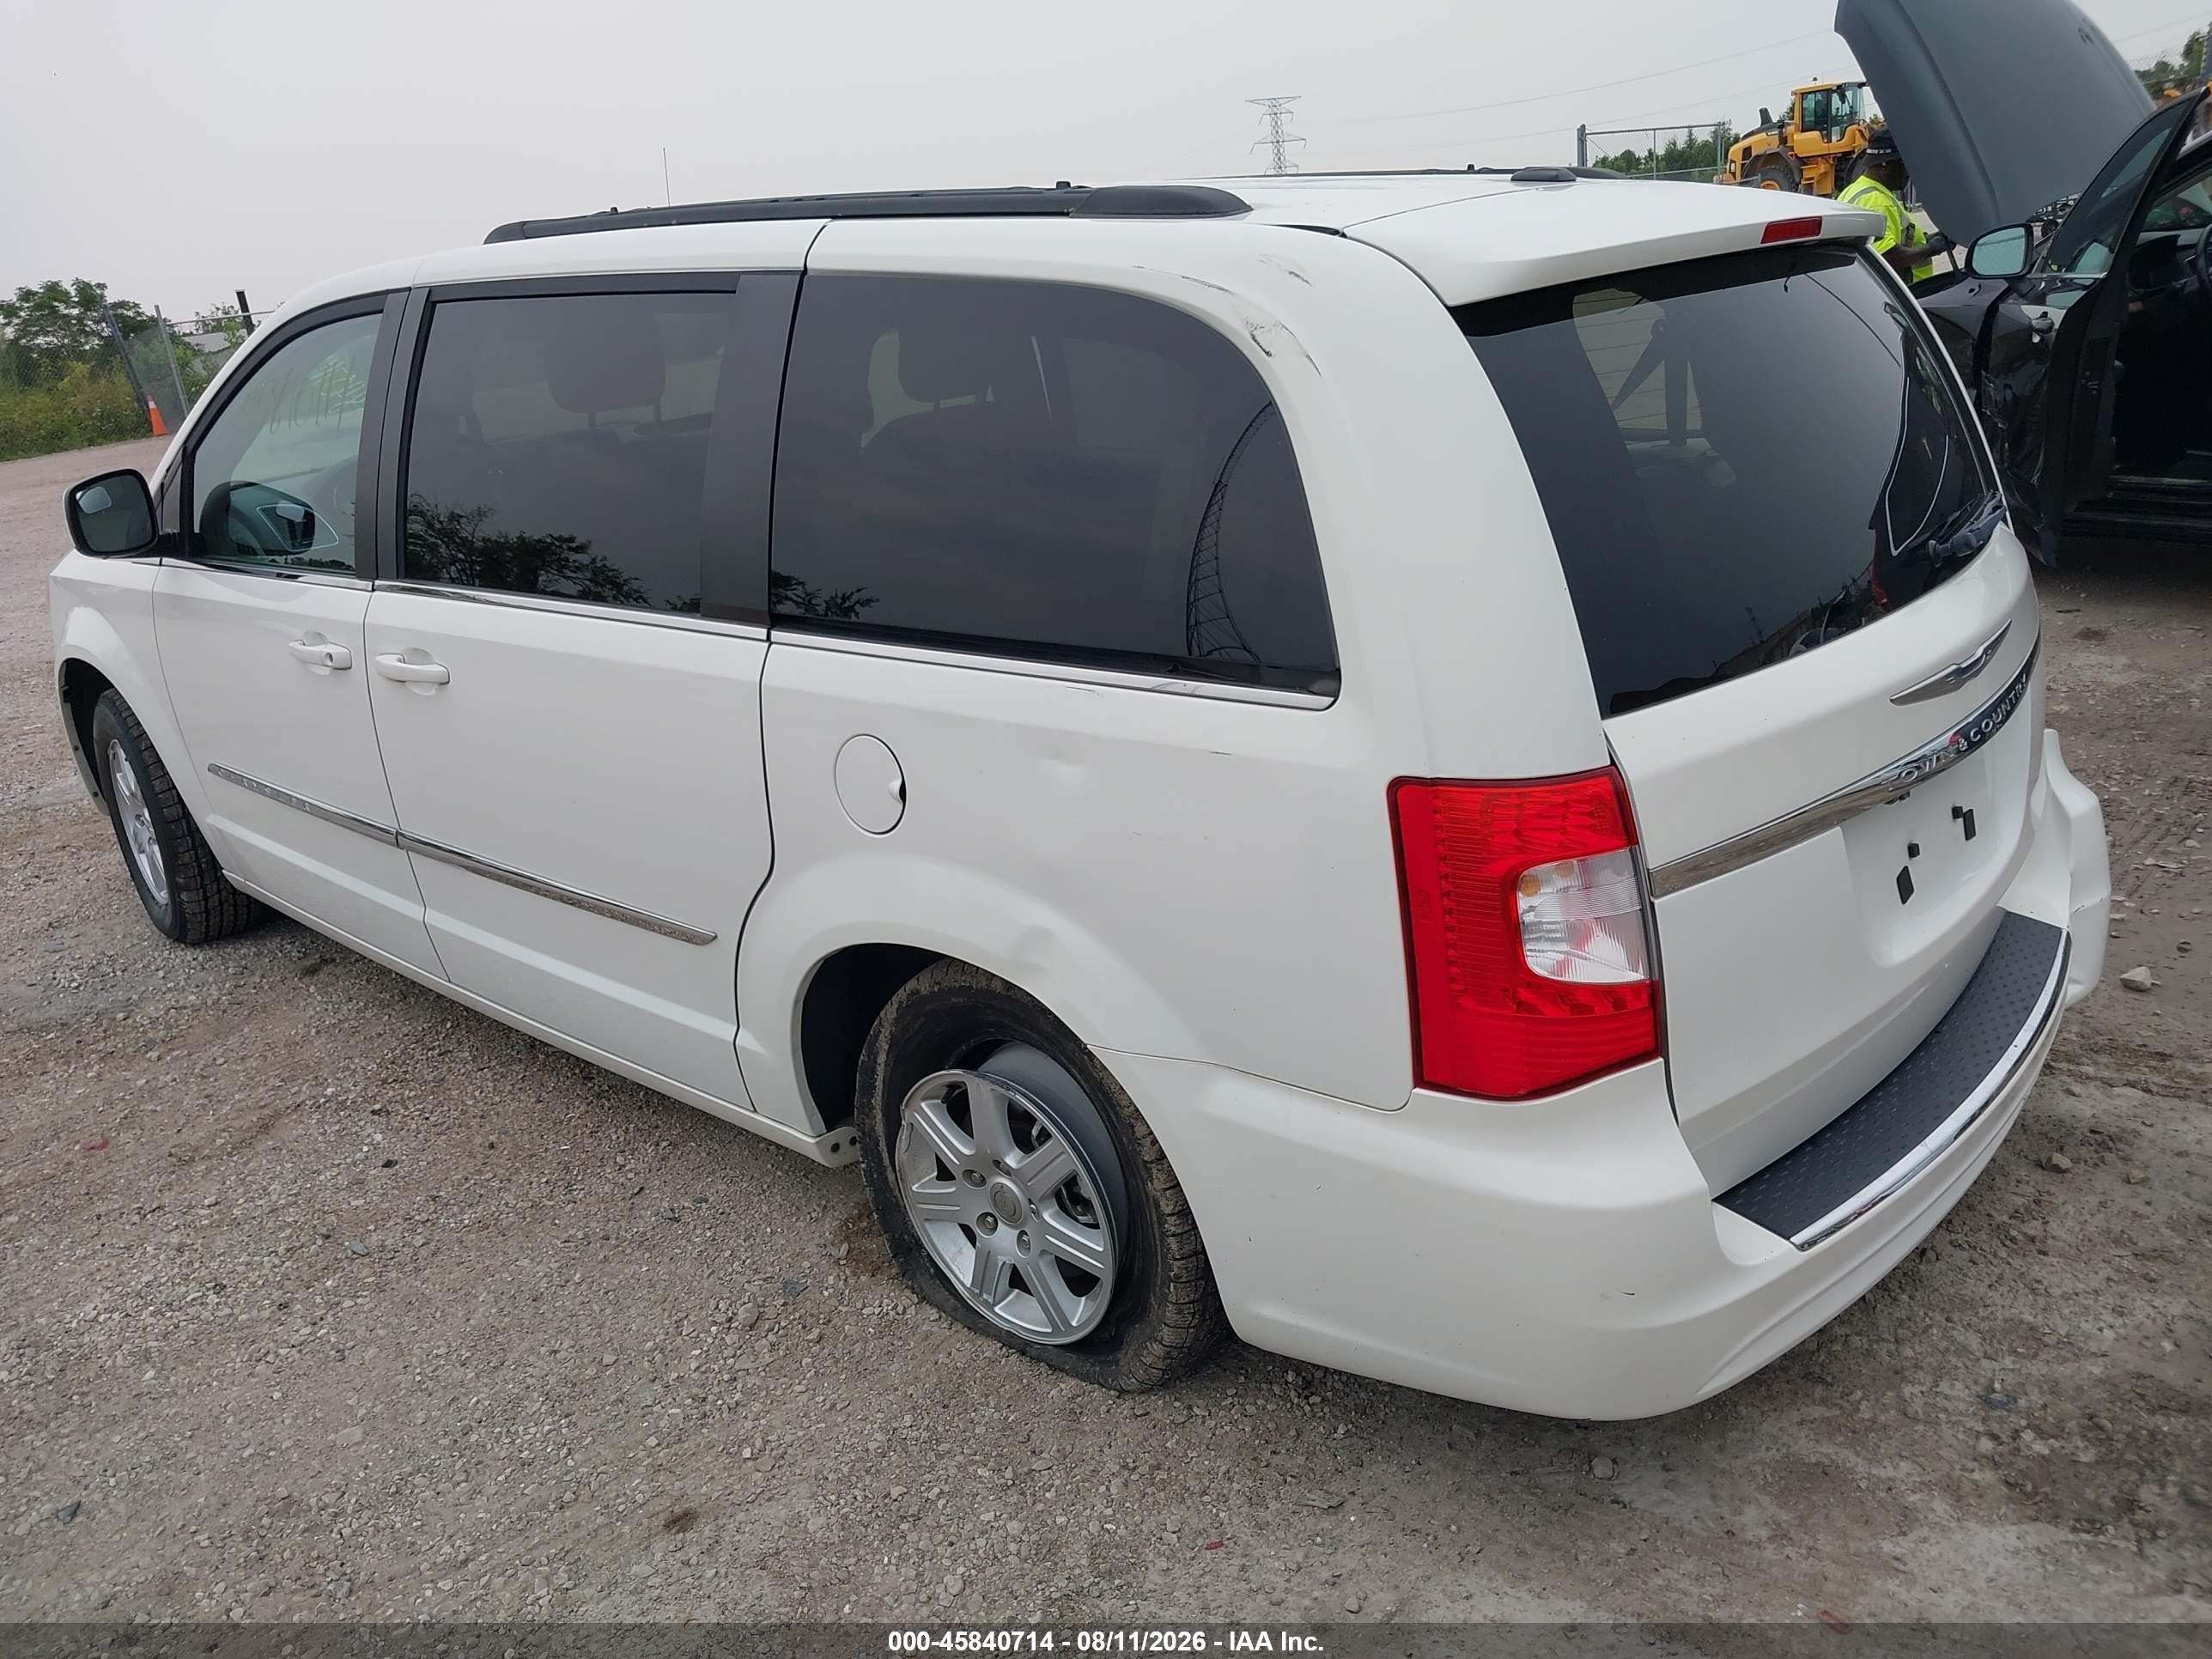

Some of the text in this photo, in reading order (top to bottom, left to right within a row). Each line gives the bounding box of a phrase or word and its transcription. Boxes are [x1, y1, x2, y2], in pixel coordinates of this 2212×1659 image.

[1881, 673, 2027, 791] TOWN & COUNTRY
